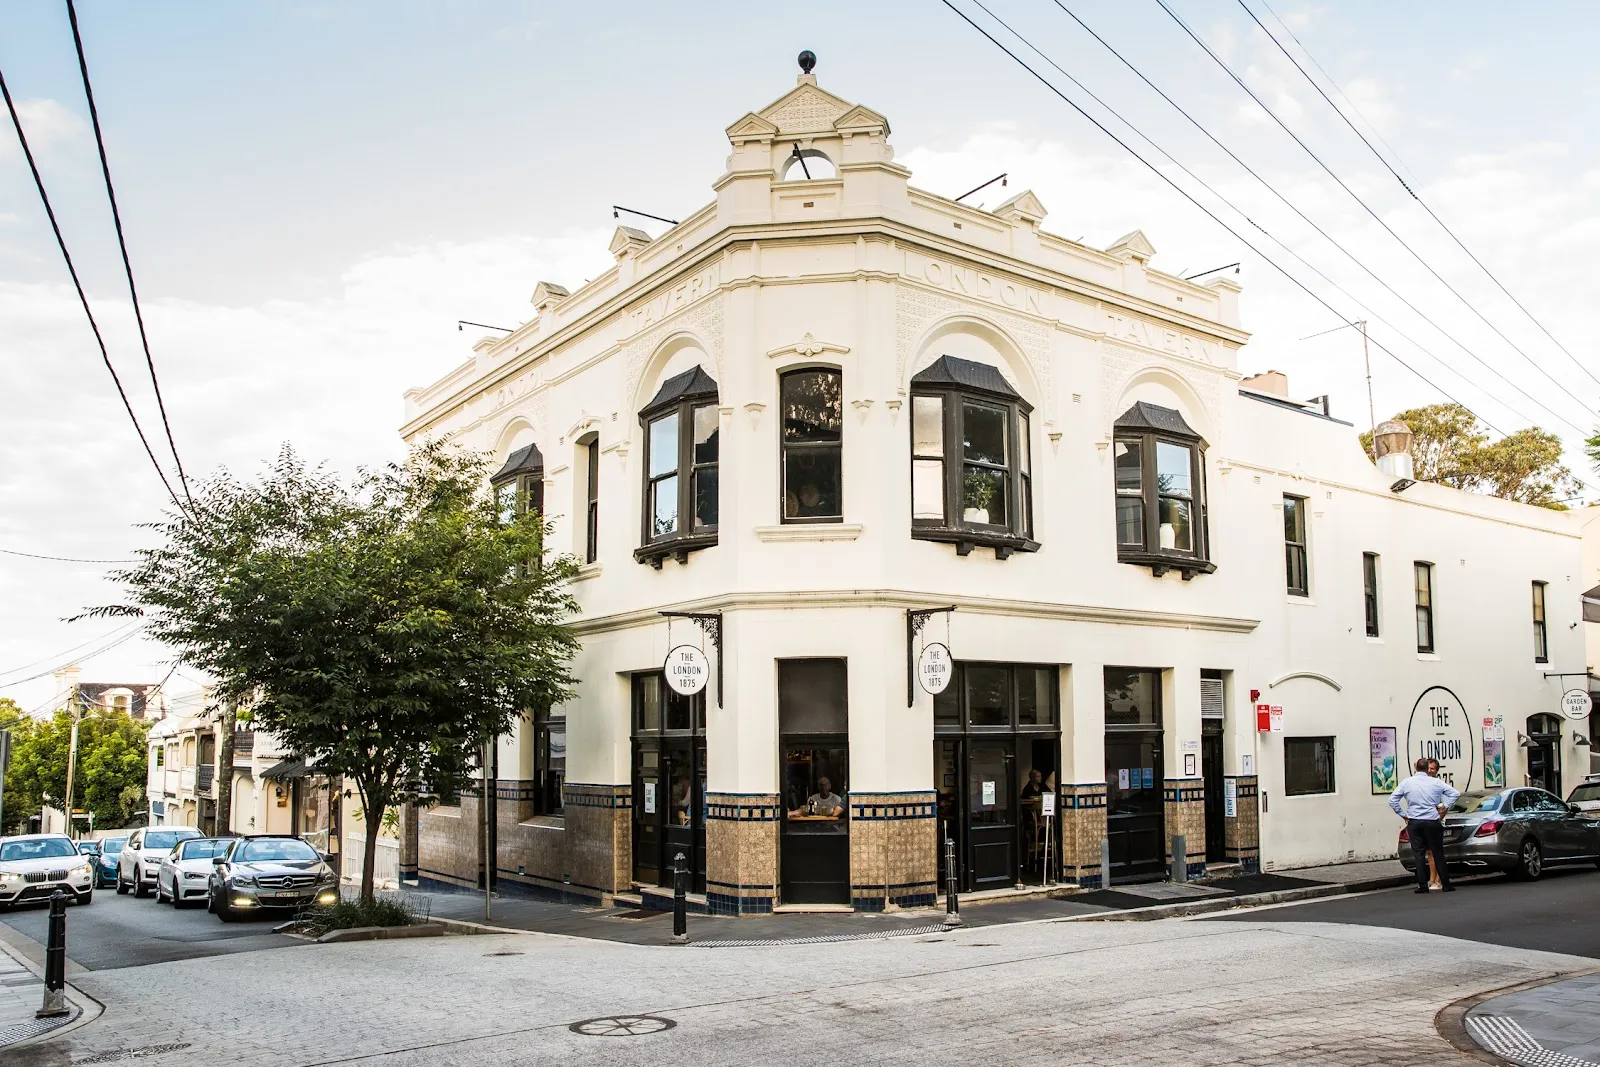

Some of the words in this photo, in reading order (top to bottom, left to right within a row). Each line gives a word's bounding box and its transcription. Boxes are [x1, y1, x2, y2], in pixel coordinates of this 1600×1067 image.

[631, 261, 721, 333] TAVERN
[903, 250, 1044, 315] LONDON
[1107, 314, 1215, 364] TAVERN
[681, 653, 694, 661] THE
[930, 651, 940, 660] THE
[673, 666, 701, 675] LONDON
[924, 664, 946, 674] LONDON
[680, 679, 696, 688] 1875
[929, 678, 941, 687] 1875
[1429, 706, 1450, 727] THE
[1421, 740, 1461, 760] LONDON
